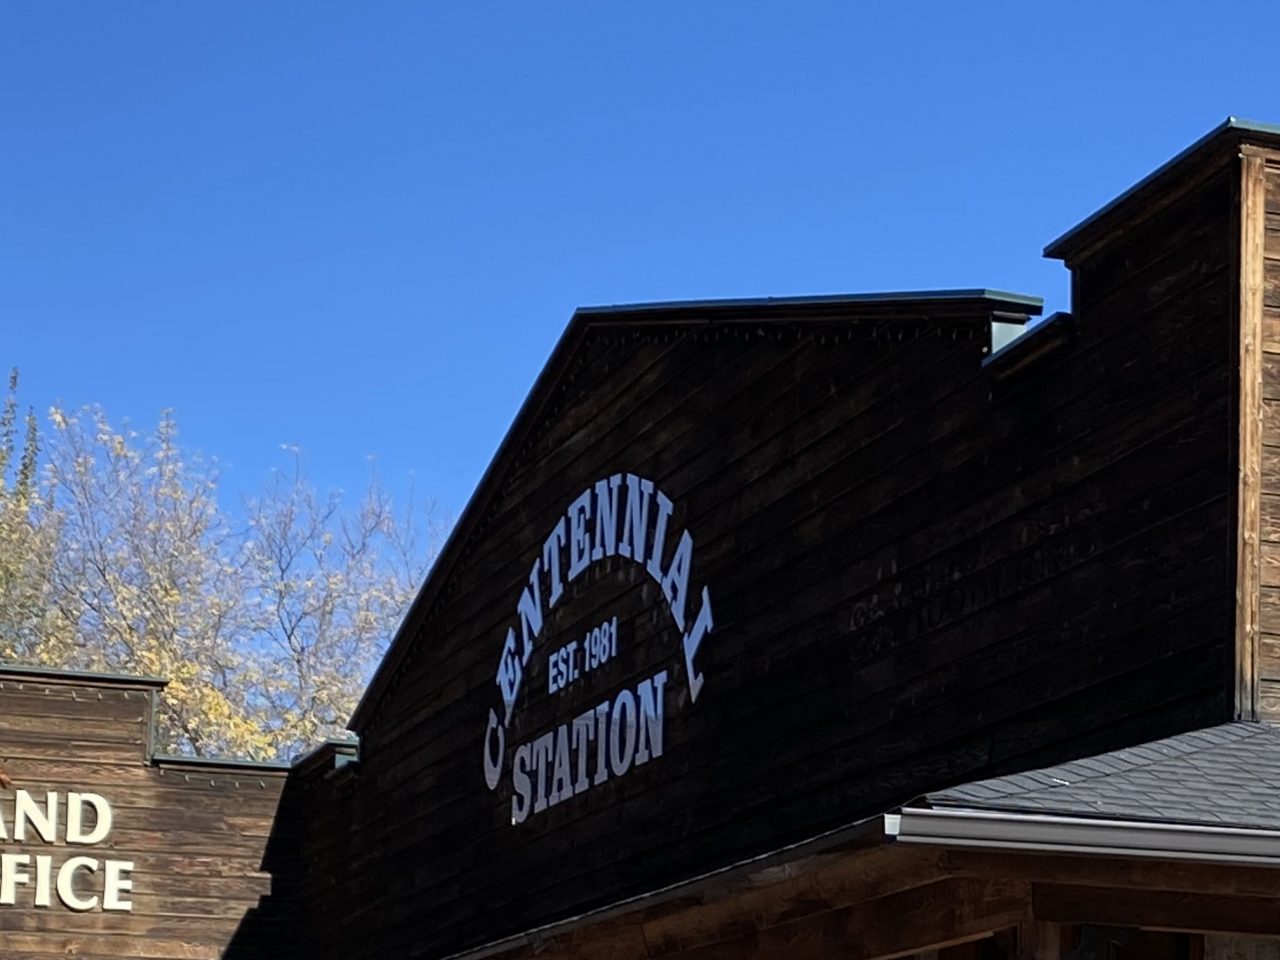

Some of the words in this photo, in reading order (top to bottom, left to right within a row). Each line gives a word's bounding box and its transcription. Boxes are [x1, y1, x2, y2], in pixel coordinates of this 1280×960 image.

[483, 472, 713, 791] CENTENNIAL
[548, 641, 579, 694] EST.
[584, 616, 618, 672] 1981
[511, 670, 668, 826] STATION
[0, 789, 112, 844] ND
